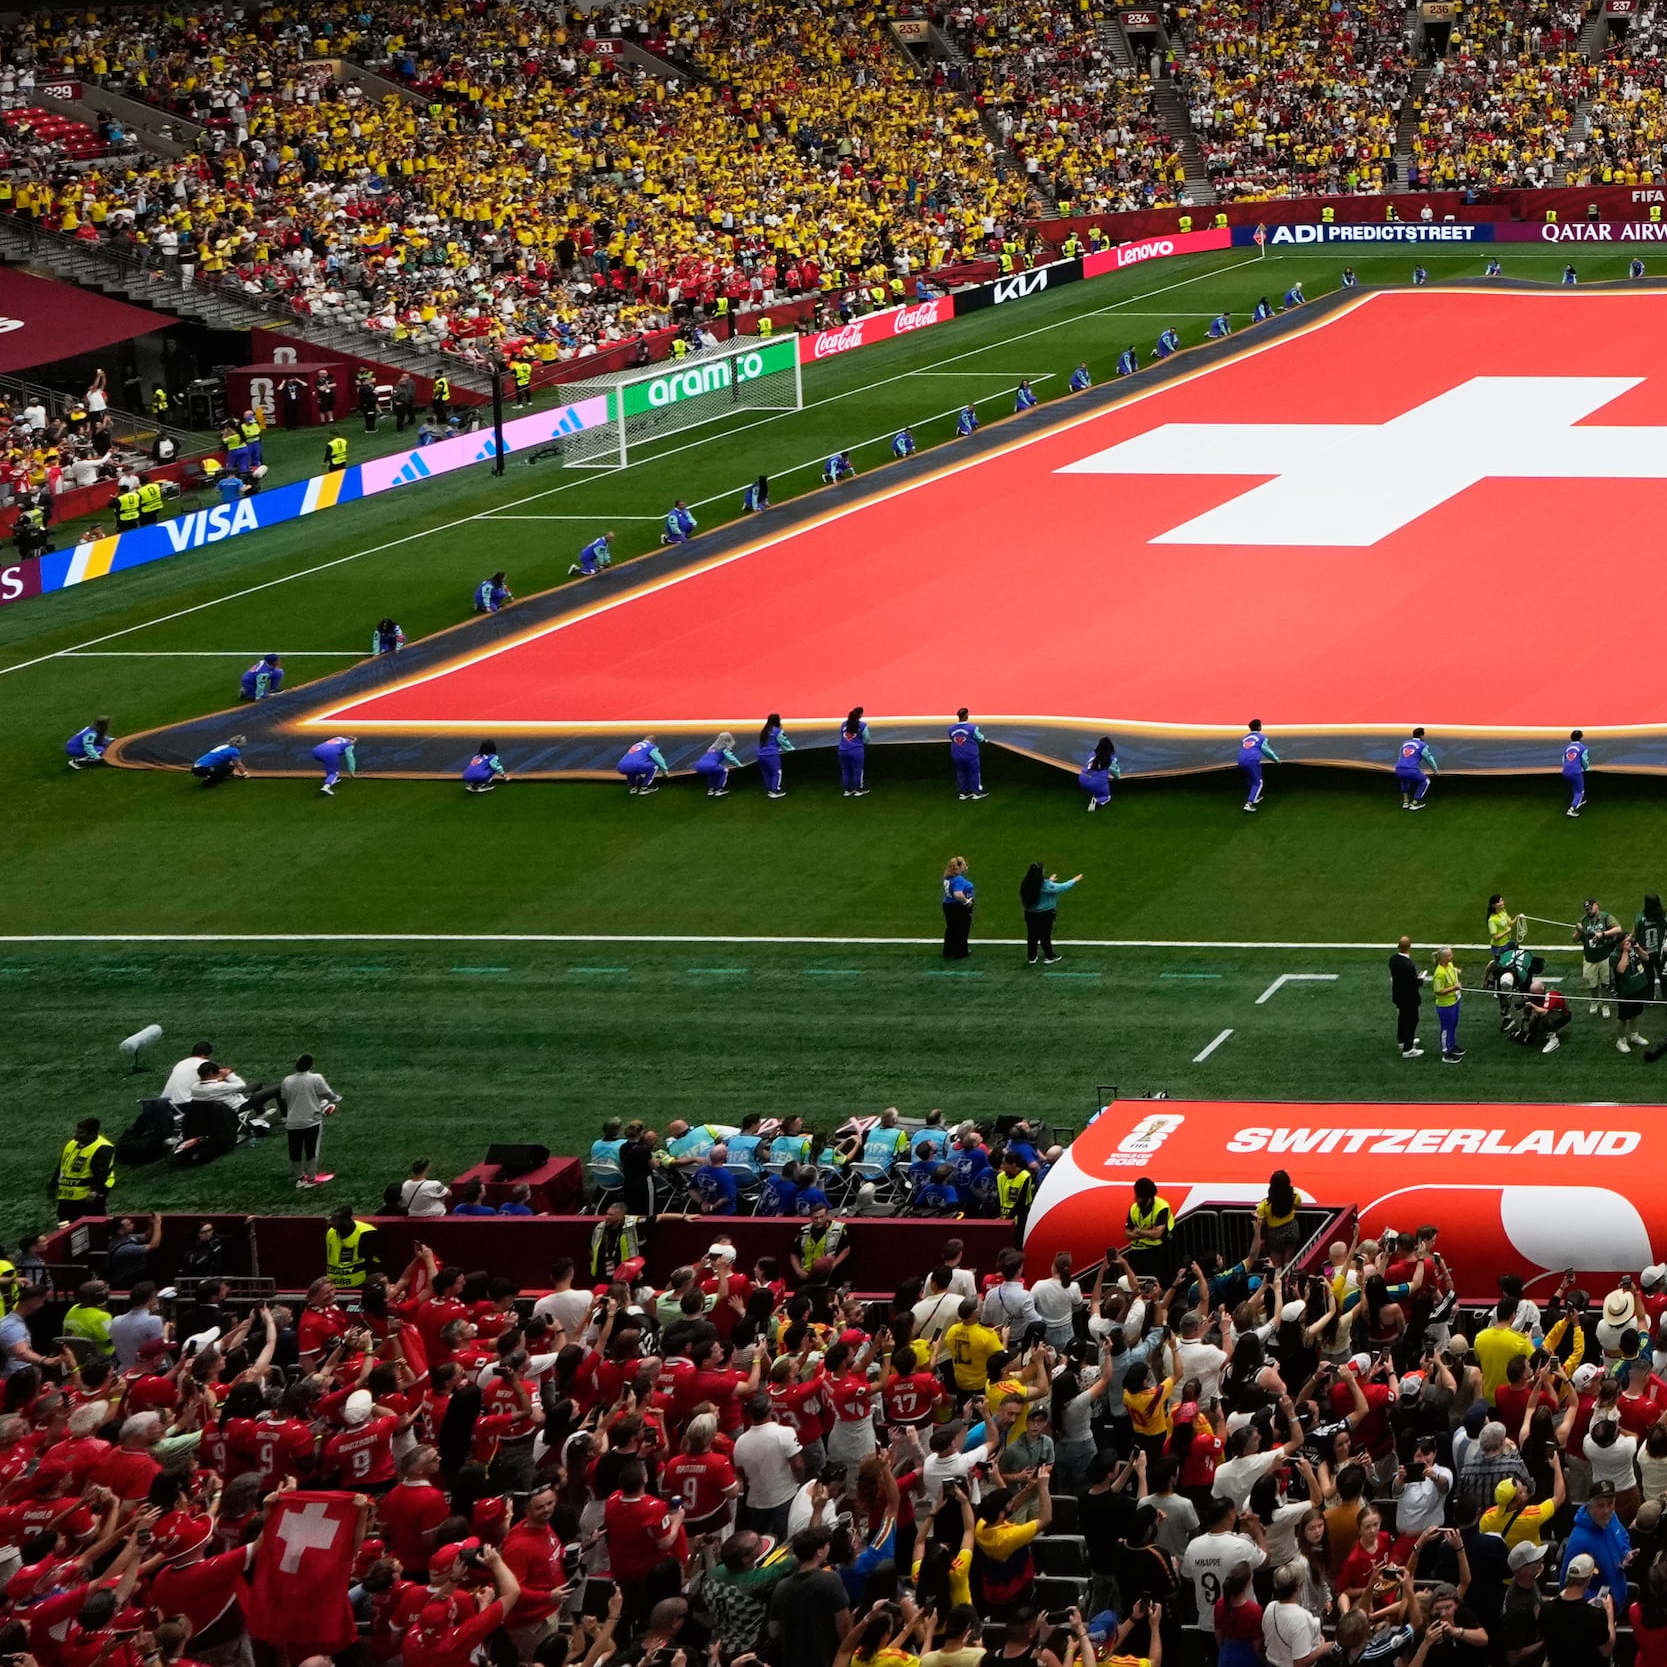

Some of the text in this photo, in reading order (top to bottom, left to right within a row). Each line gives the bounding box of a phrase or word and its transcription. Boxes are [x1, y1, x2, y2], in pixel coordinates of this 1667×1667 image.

[1632, 191, 1665, 203] FIFA
[1271, 224, 1475, 244] ADI PREDICTSTREET
[1541, 223, 1615, 244] QATAR
[1117, 240, 1174, 267] Lenovo
[994, 269, 1048, 304] KIA
[894, 299, 938, 334] Coca-Cola
[814, 321, 863, 358] Coca-Cola
[157, 496, 259, 552] VISA
[1225, 1128, 1643, 1156] SWITZERLAND
[1103, 1158, 1150, 1167] 2026
[891, 1392, 918, 1413] 17
[353, 1447, 371, 1479] 9
[682, 1476, 698, 1505] 9
[1201, 1572, 1221, 1604] 9
